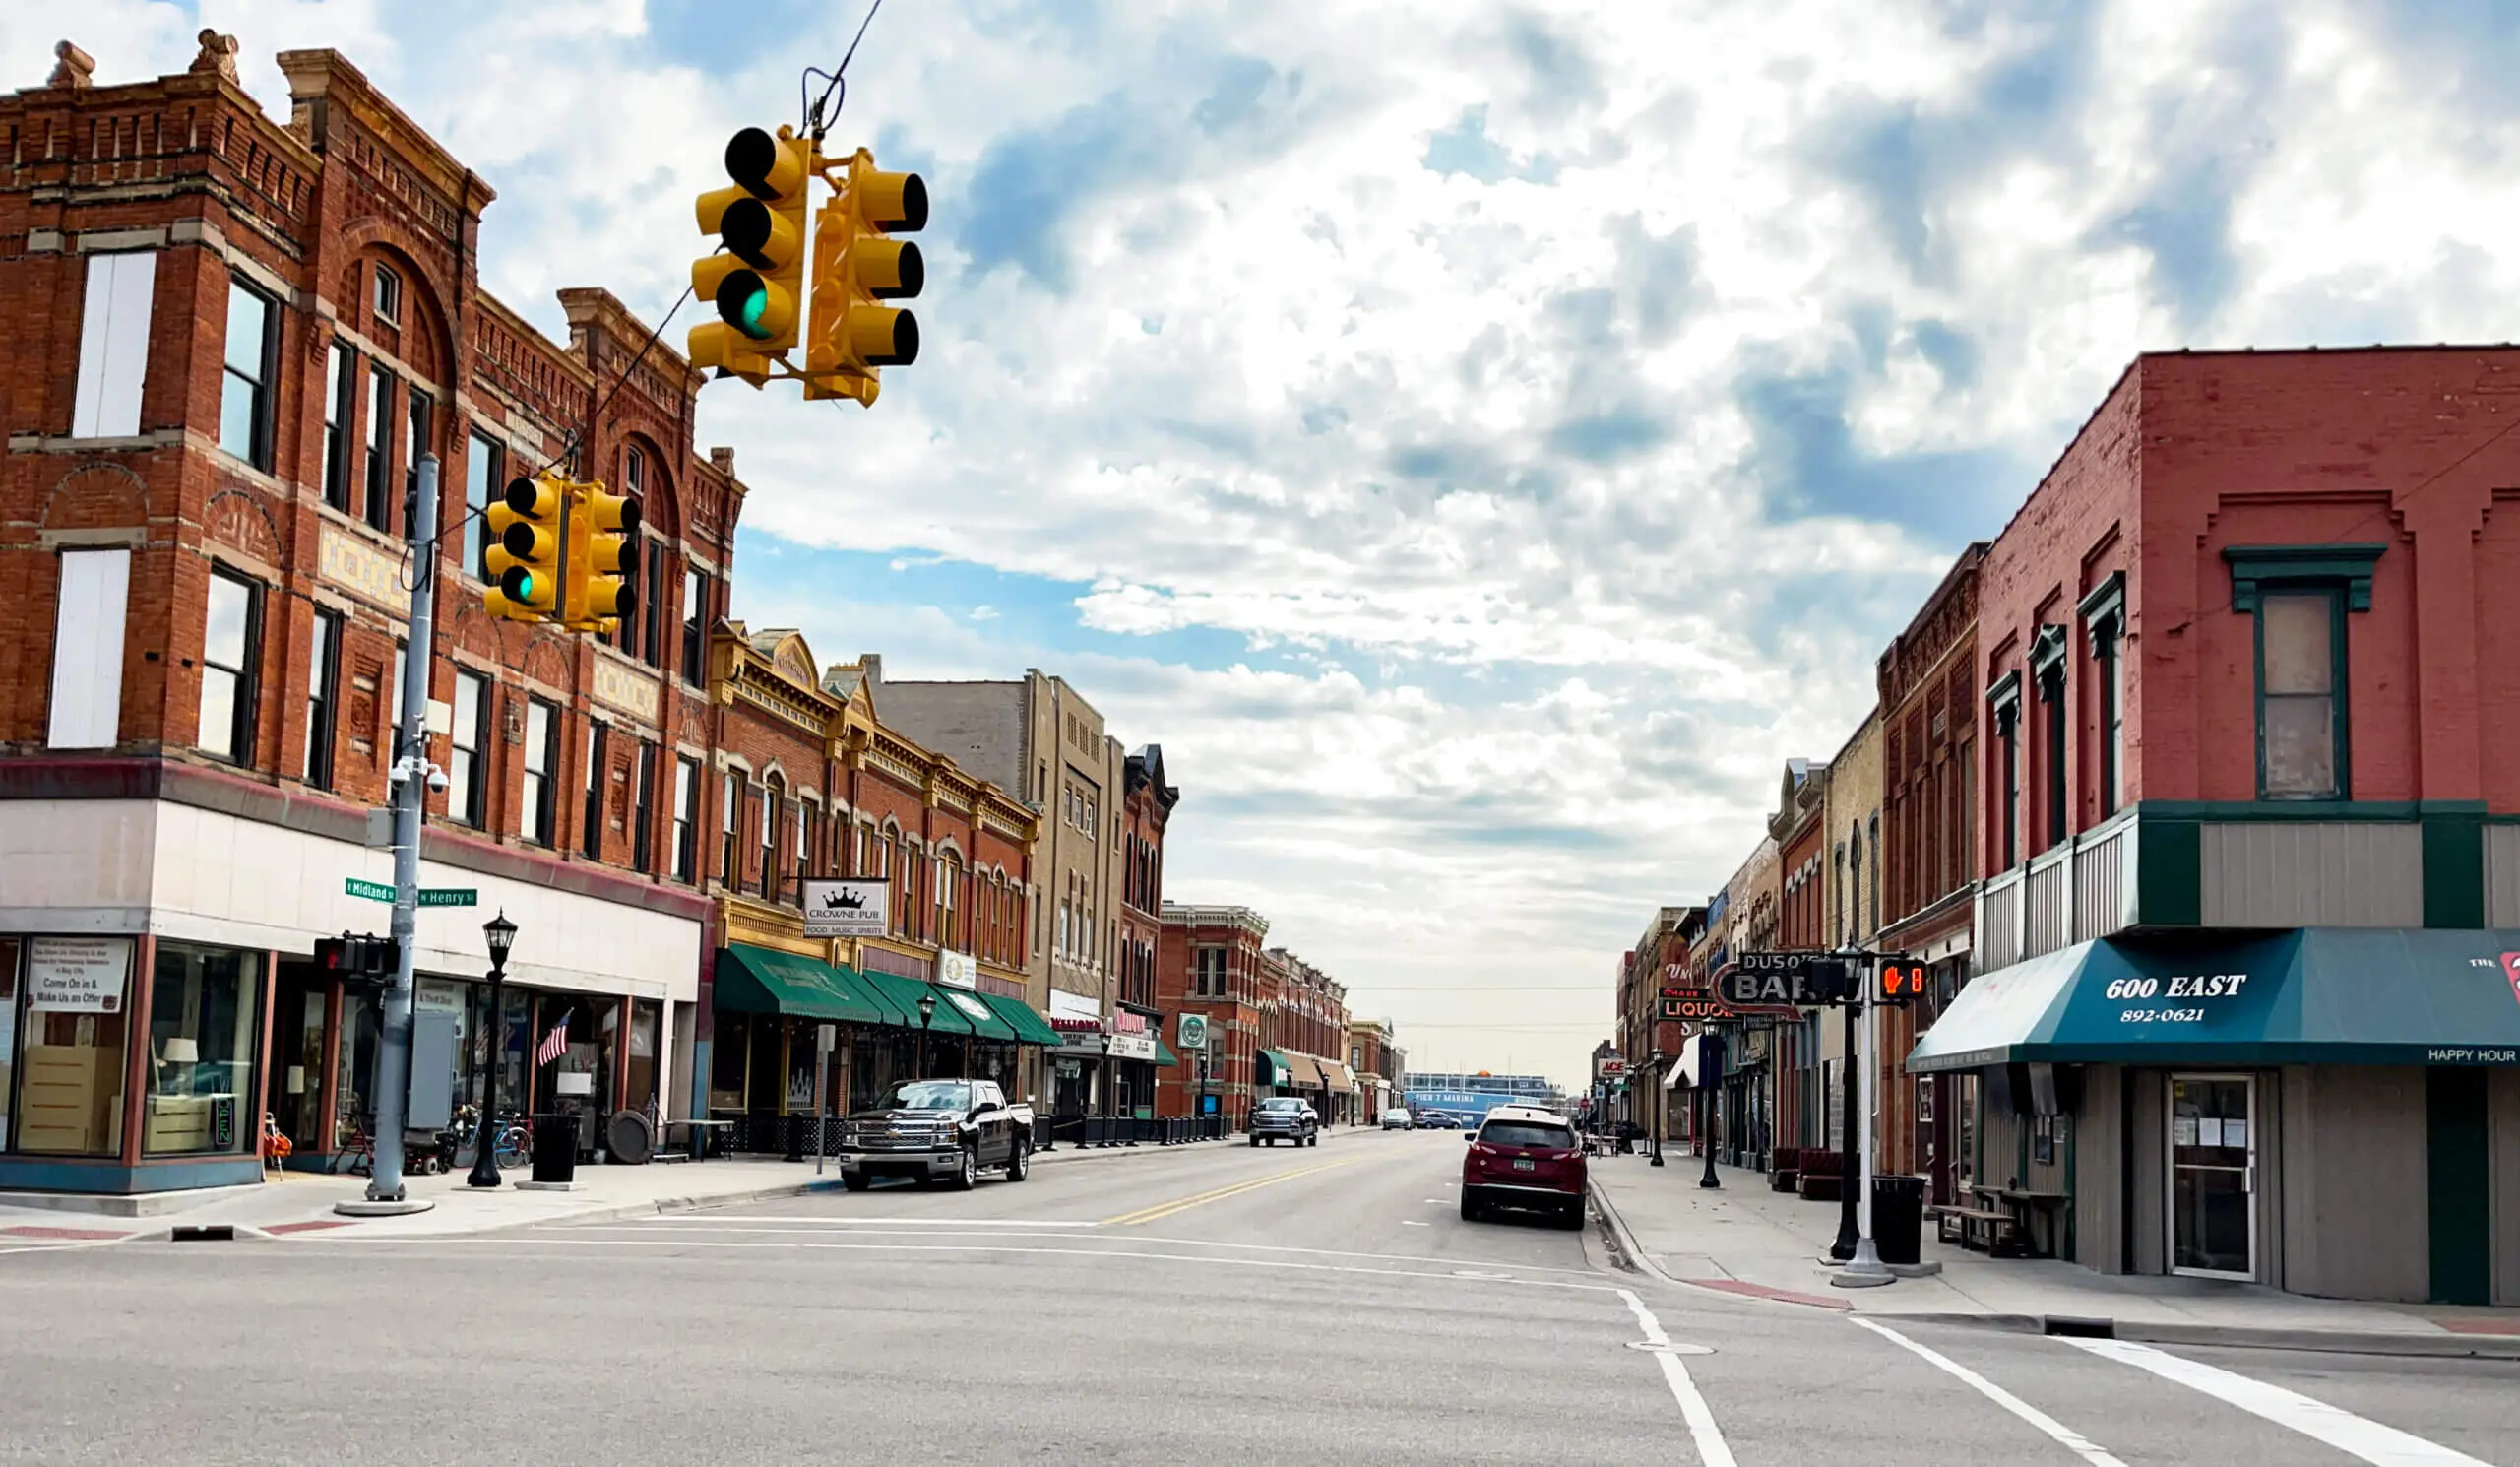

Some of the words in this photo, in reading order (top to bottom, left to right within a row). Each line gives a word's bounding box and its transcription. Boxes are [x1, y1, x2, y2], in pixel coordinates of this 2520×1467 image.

[354, 885, 387, 900] Midland
[430, 892, 464, 905] Henry
[809, 909, 856, 919] CROWNE
[859, 910, 879, 919] PUB
[2468, 958, 2496, 968] THE
[43, 978, 67, 988] Come
[69, 978, 81, 988] On
[2106, 977, 2158, 999] 600
[2164, 974, 2247, 997] EAST
[37, 992, 57, 1002] Make
[59, 993, 69, 1002] Us
[83, 993, 101, 1003] Offer
[2428, 1049, 2474, 1061] HAPPY
[2478, 1050, 2517, 1062] HOUR
[1602, 1061, 1624, 1071] ACE
[1416, 1093, 1433, 1102] PIER
[220, 1098, 230, 1142] OPEN
